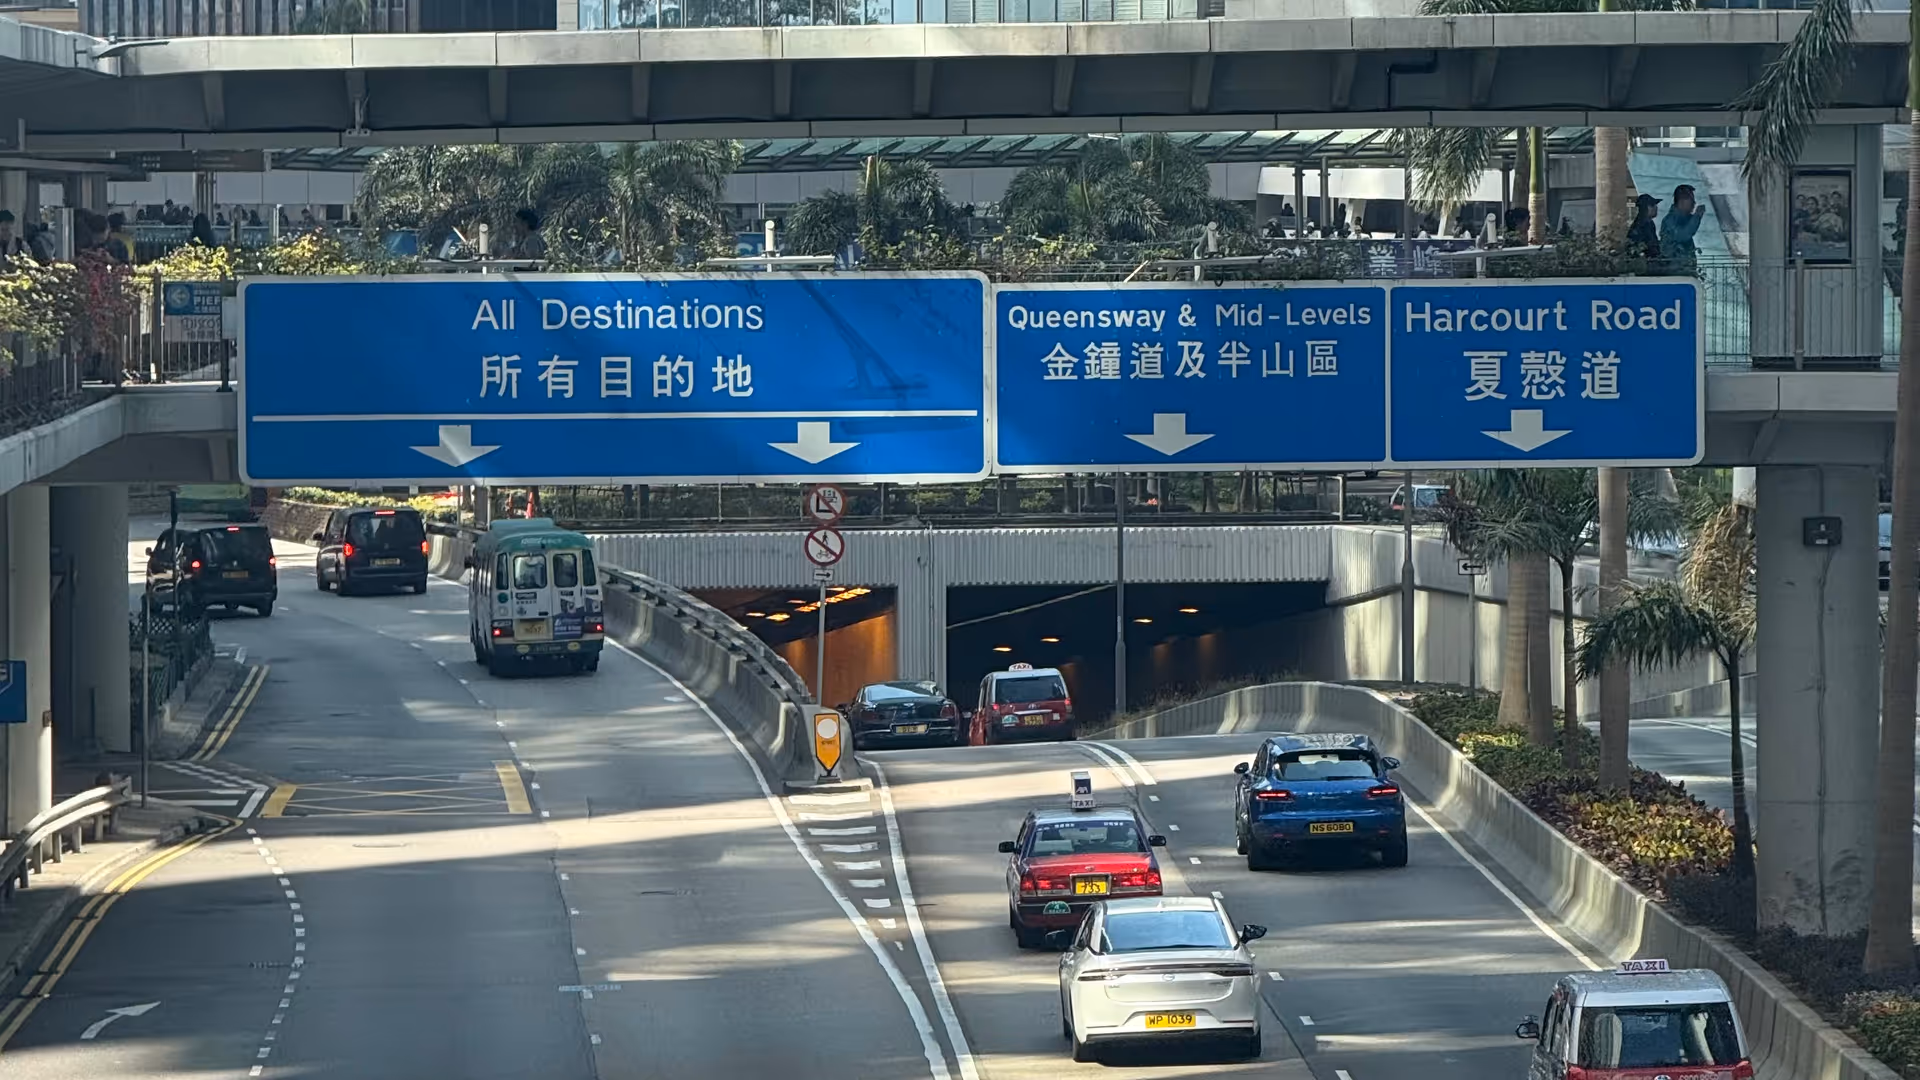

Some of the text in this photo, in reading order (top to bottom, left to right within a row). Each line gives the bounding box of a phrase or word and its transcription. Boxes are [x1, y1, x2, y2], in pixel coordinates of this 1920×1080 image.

[472, 298, 763, 330] All Destinations
[1008, 303, 1371, 332] Queensway & Mid-Levels
[1406, 299, 1681, 332] Harcourt Road
[1040, 340, 1338, 381] 金鐘道及半山區
[479, 354, 754, 399] 所有目的地
[1312, 824, 1325, 832] NS
[1621, 960, 1666, 971] TAXI
[1148, 1014, 1193, 1026] WP 1039
